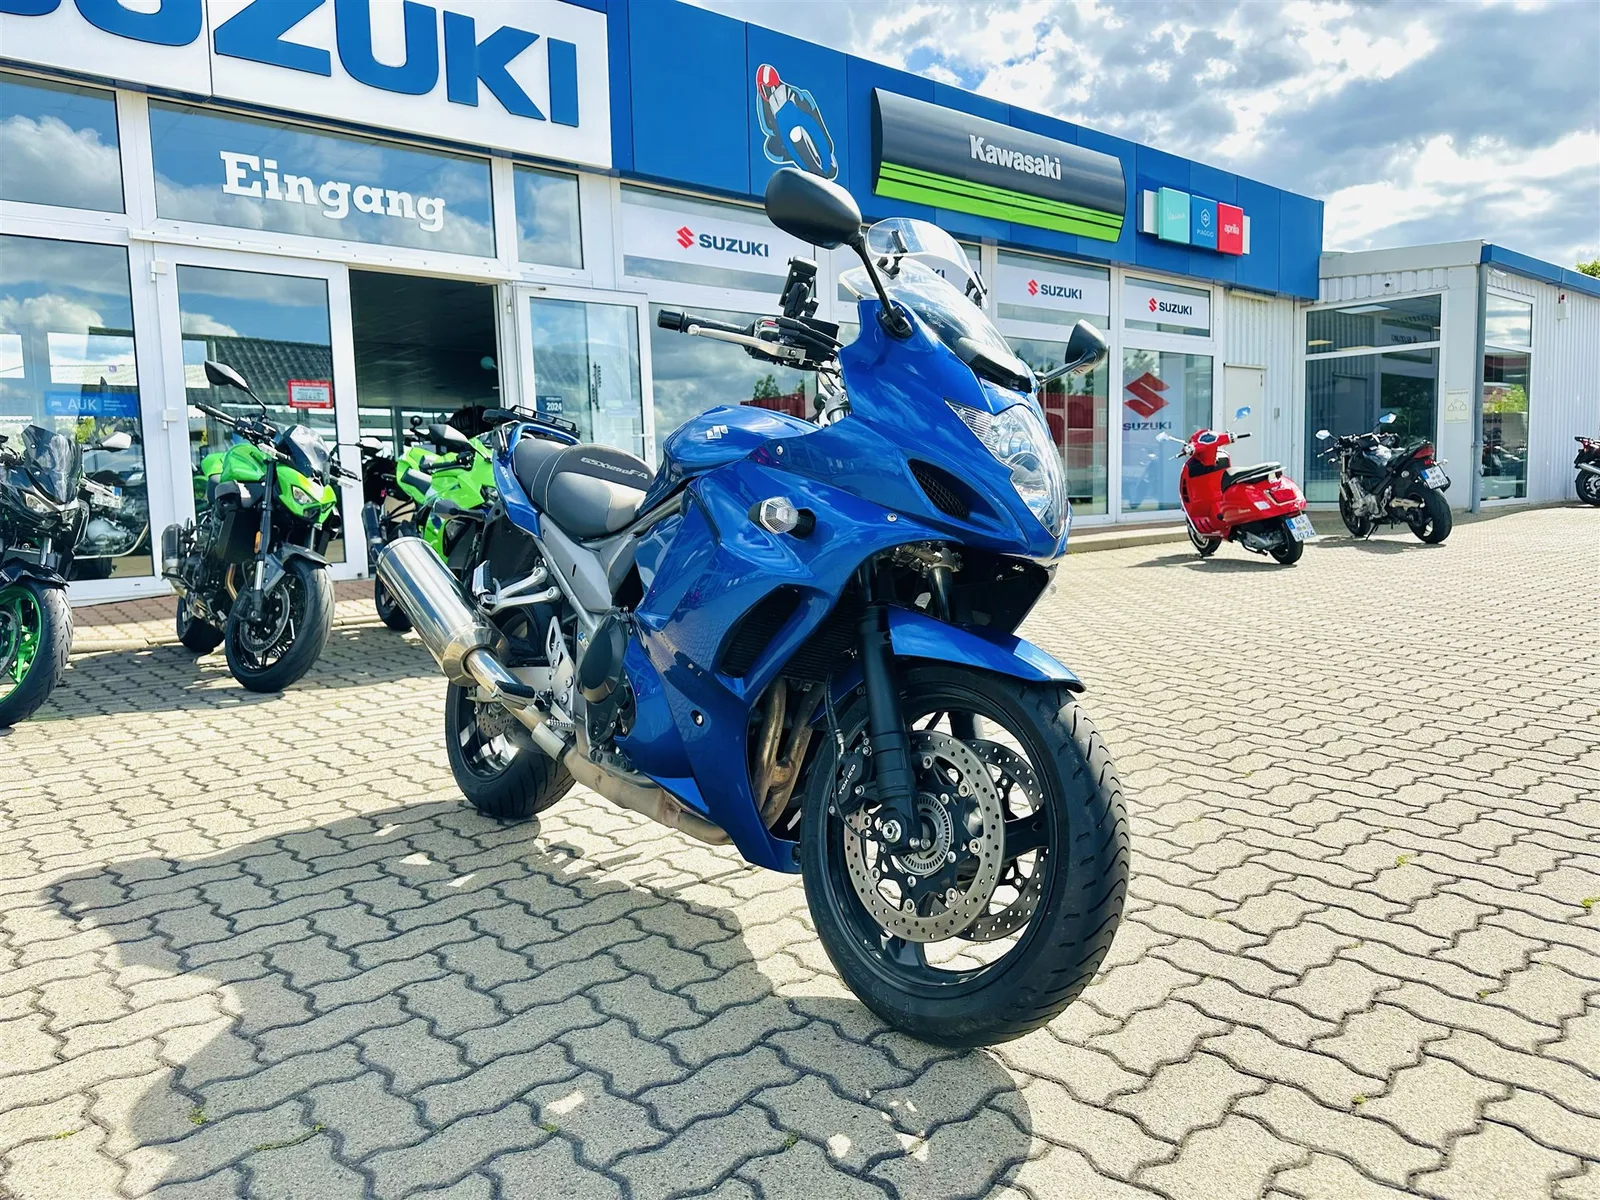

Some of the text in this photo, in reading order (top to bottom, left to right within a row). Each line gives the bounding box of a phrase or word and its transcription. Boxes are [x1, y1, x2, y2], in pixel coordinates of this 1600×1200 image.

[969, 134, 1062, 181] Kawasaki
[219, 150, 446, 231] Eingang
[698, 233, 769, 257] SUZUKI
[1040, 283, 1083, 300] SUZUKI
[1158, 301, 1193, 316] SUZUKI
[67, 399, 97, 412] AUK
[546, 402, 563, 411] 2024
[1122, 421, 1172, 432] SUZUKI
[838, 764, 856, 795] TOKICO
